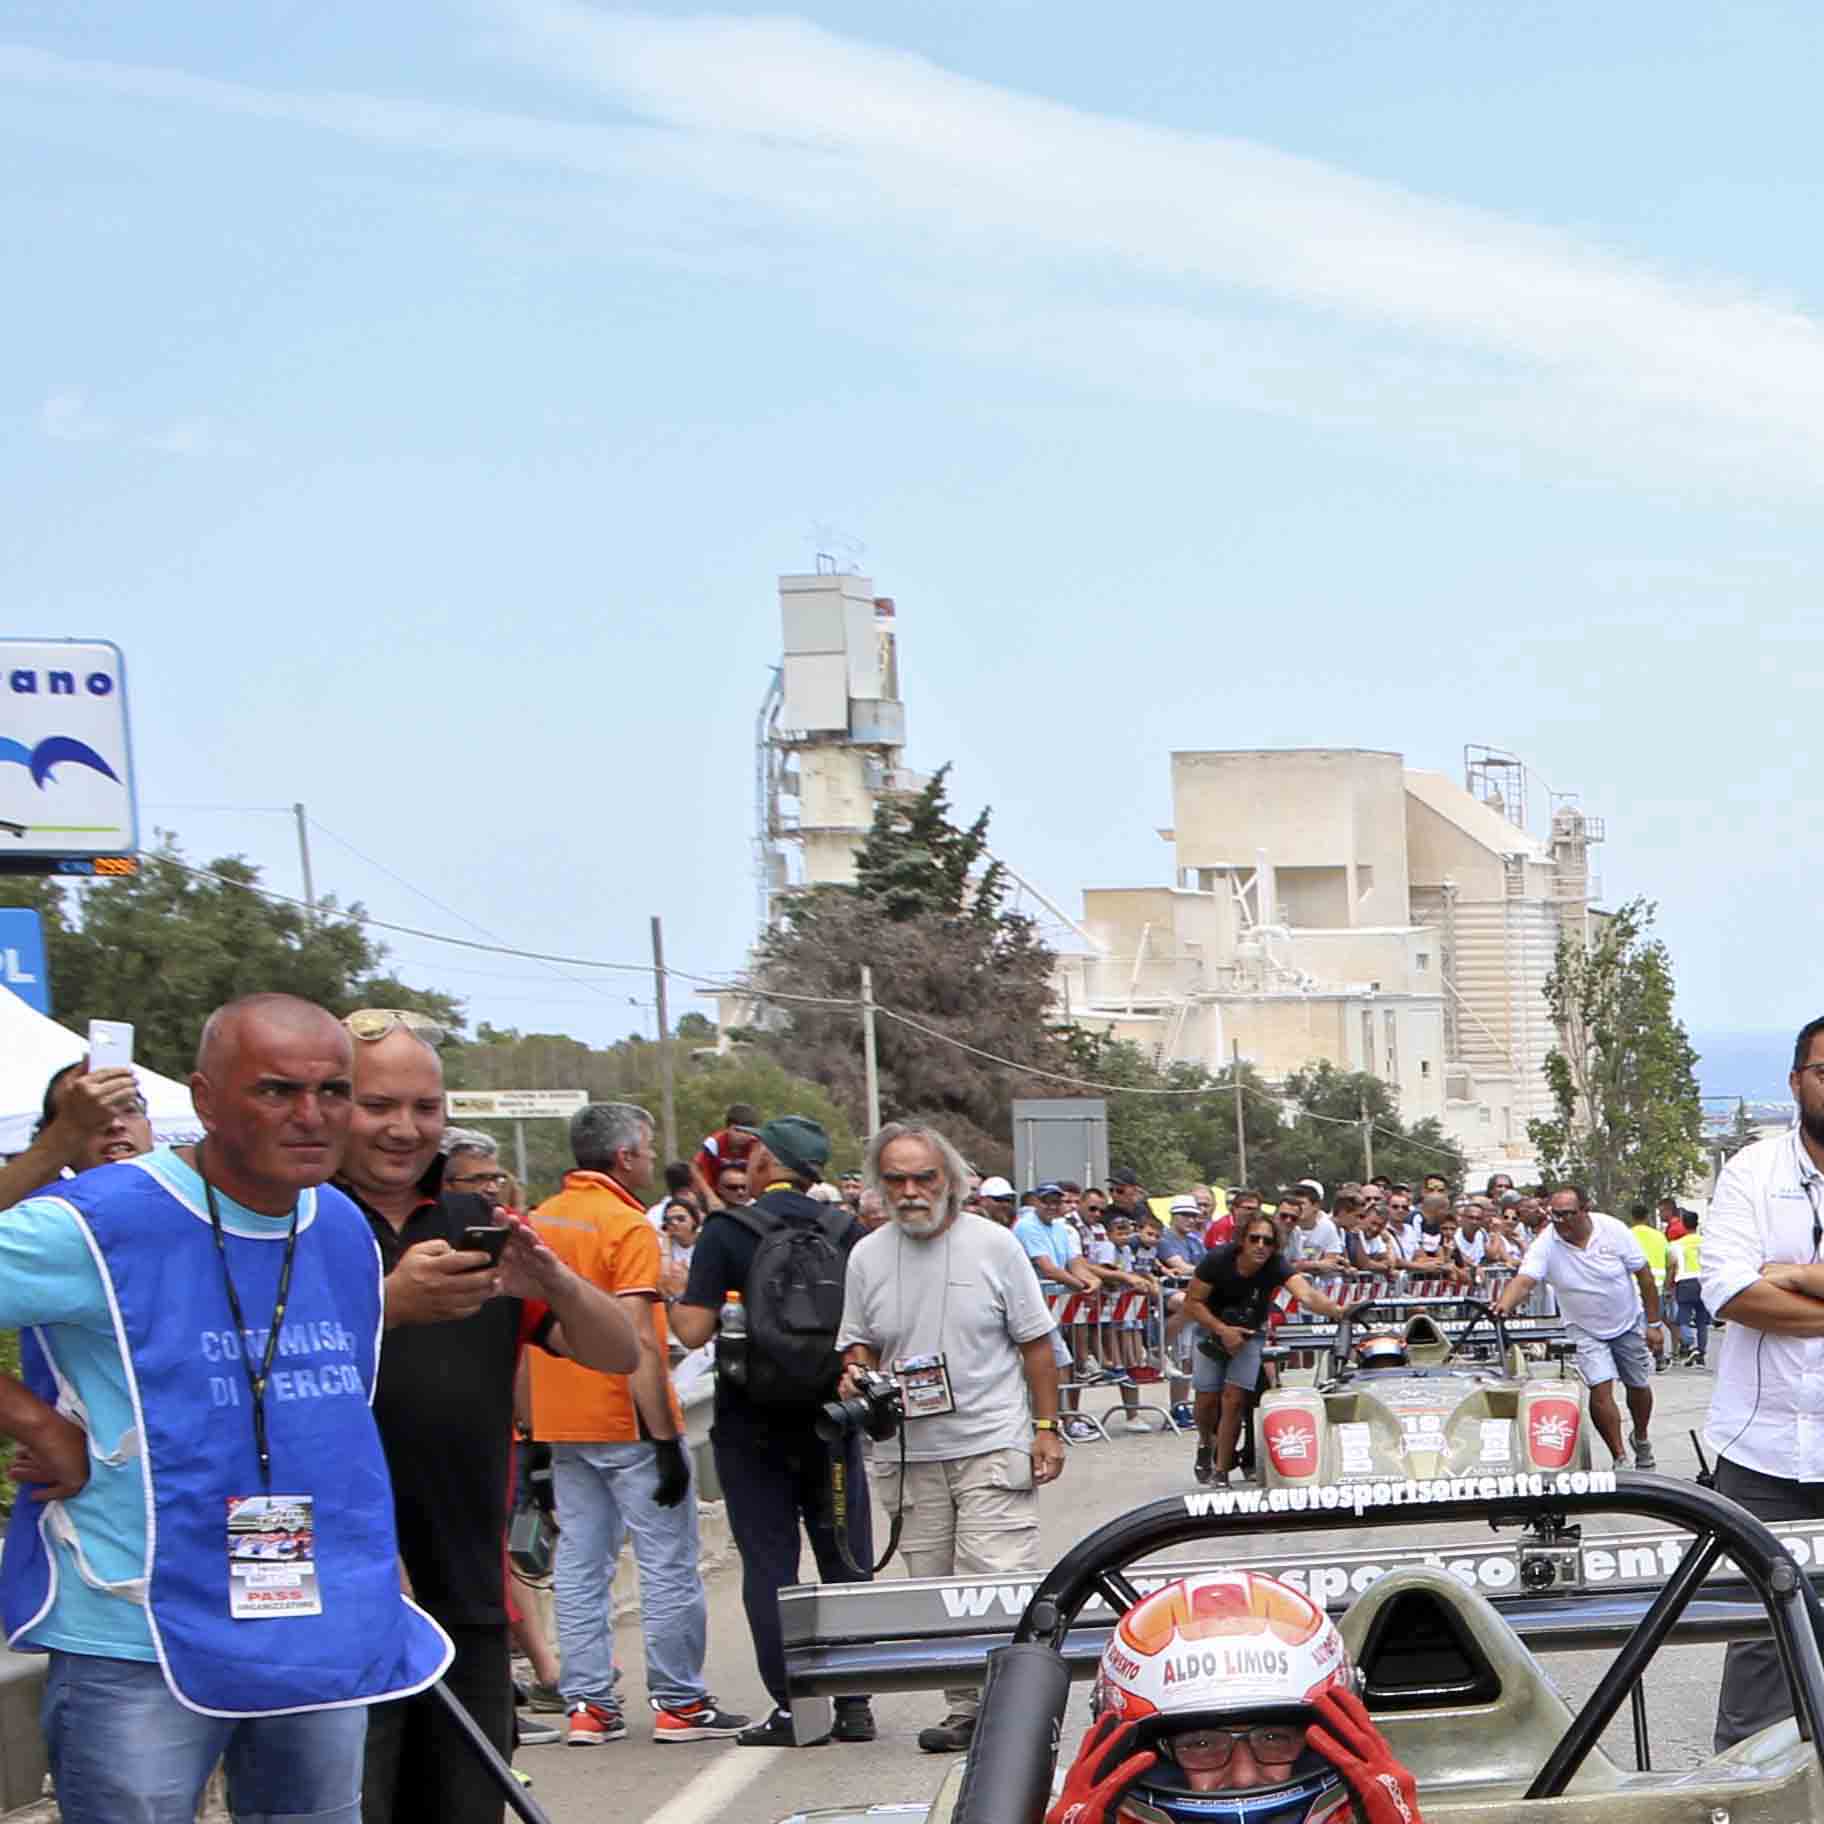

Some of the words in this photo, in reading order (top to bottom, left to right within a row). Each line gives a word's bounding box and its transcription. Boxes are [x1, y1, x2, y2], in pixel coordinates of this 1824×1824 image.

[0, 669, 113, 696] ano
[1185, 1469, 1618, 1517] www.autosportsorrento.com
[1163, 1654, 1216, 1685] ALDO
[1225, 1649, 1289, 1677] LIMOS
